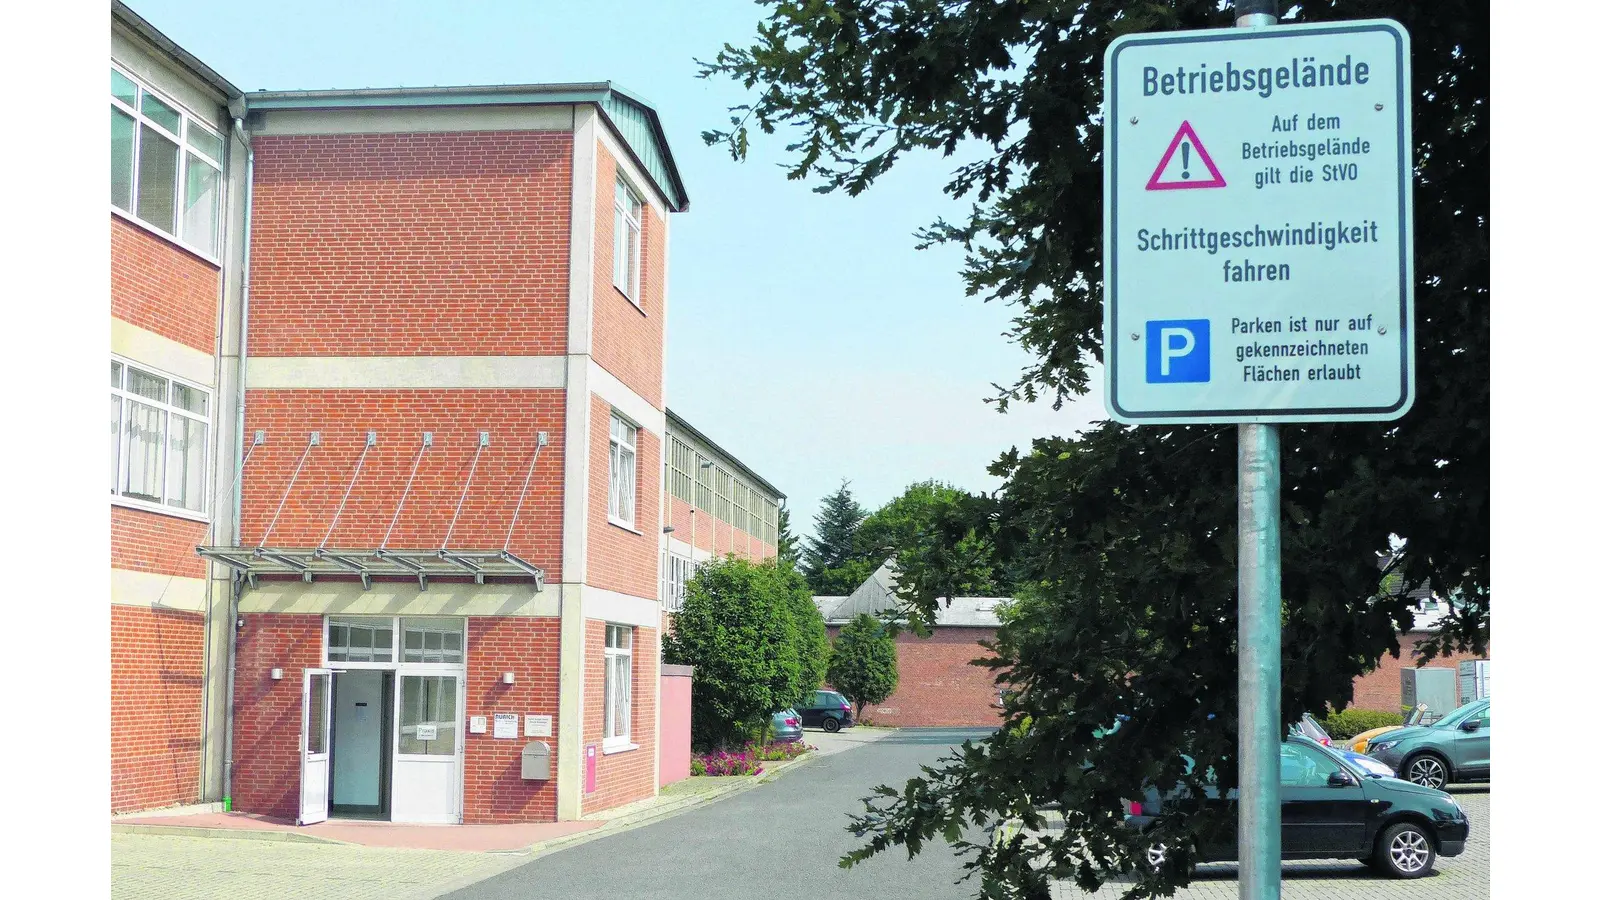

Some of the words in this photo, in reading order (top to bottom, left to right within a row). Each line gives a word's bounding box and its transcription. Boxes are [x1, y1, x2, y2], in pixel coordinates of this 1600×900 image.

[1143, 55, 1369, 98] Betriebsgelände
[1272, 114, 1298, 132] Auf
[1307, 113, 1341, 131] dem
[1242, 137, 1371, 161] Betriebsgelände
[1255, 167, 1281, 189] gilt
[1290, 165, 1314, 184] die
[1322, 163, 1358, 182] StVO
[1137, 220, 1378, 254] Schrittgeschwindigkeit
[1223, 259, 1290, 283] fahren
[1231, 317, 1282, 334] Parken
[1289, 316, 1308, 333] ist
[1315, 319, 1340, 332] nur
[1348, 314, 1373, 332] auf
[1160, 327, 1195, 376] P
[1236, 340, 1369, 361] gekennzeichneten
[1243, 364, 1300, 383] Flächen
[1307, 362, 1361, 381] erlaubt
